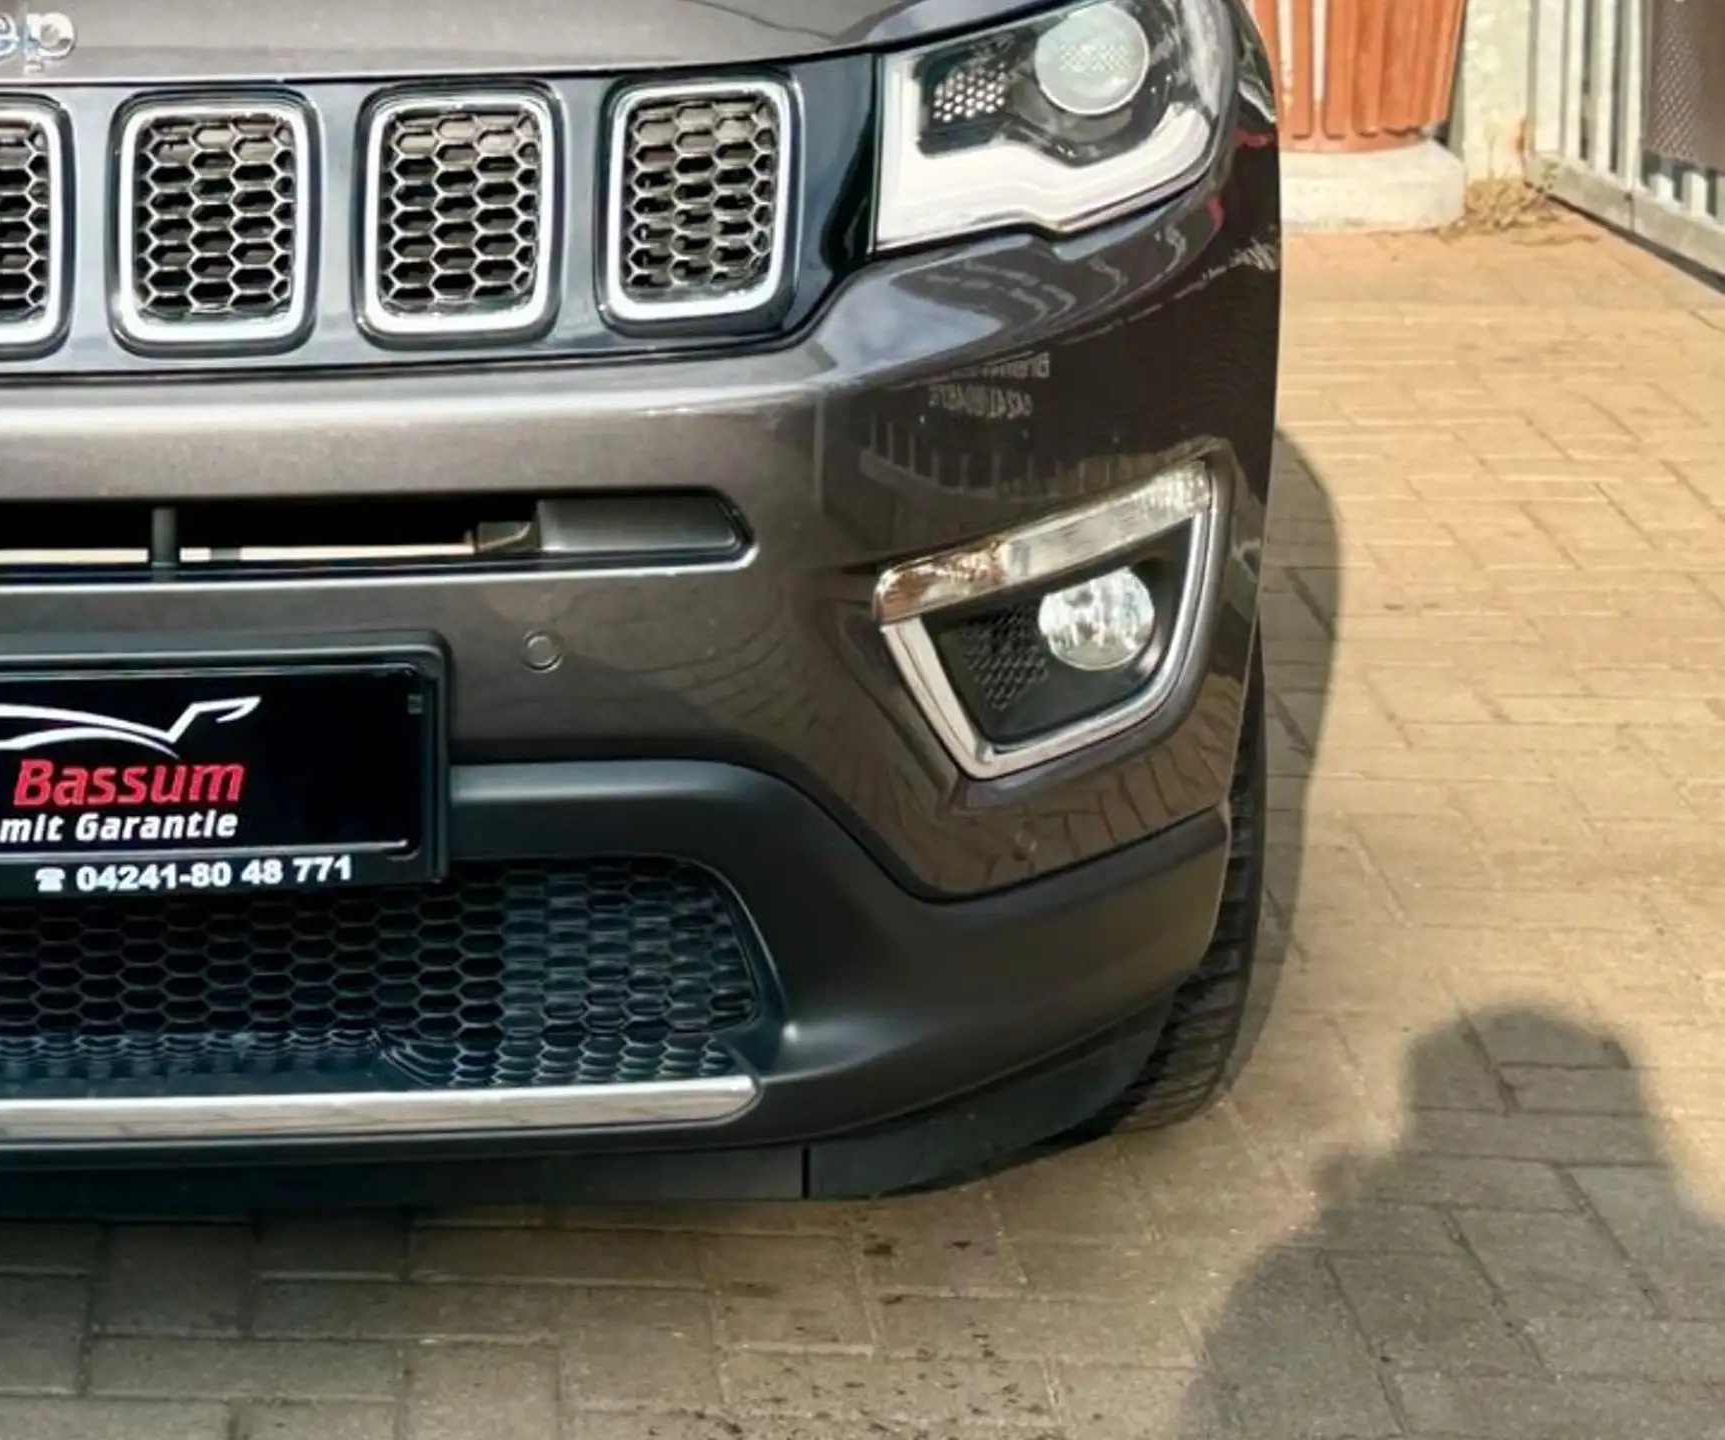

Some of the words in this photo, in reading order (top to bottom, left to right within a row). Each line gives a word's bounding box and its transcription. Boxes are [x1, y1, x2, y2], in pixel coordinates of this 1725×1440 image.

[13, 759, 246, 807] Bassum
[0, 814, 65, 843] mit
[75, 810, 239, 841] Garantie
[76, 862, 232, 892] 04241-80
[241, 860, 283, 885] 48
[292, 856, 353, 882] 771
